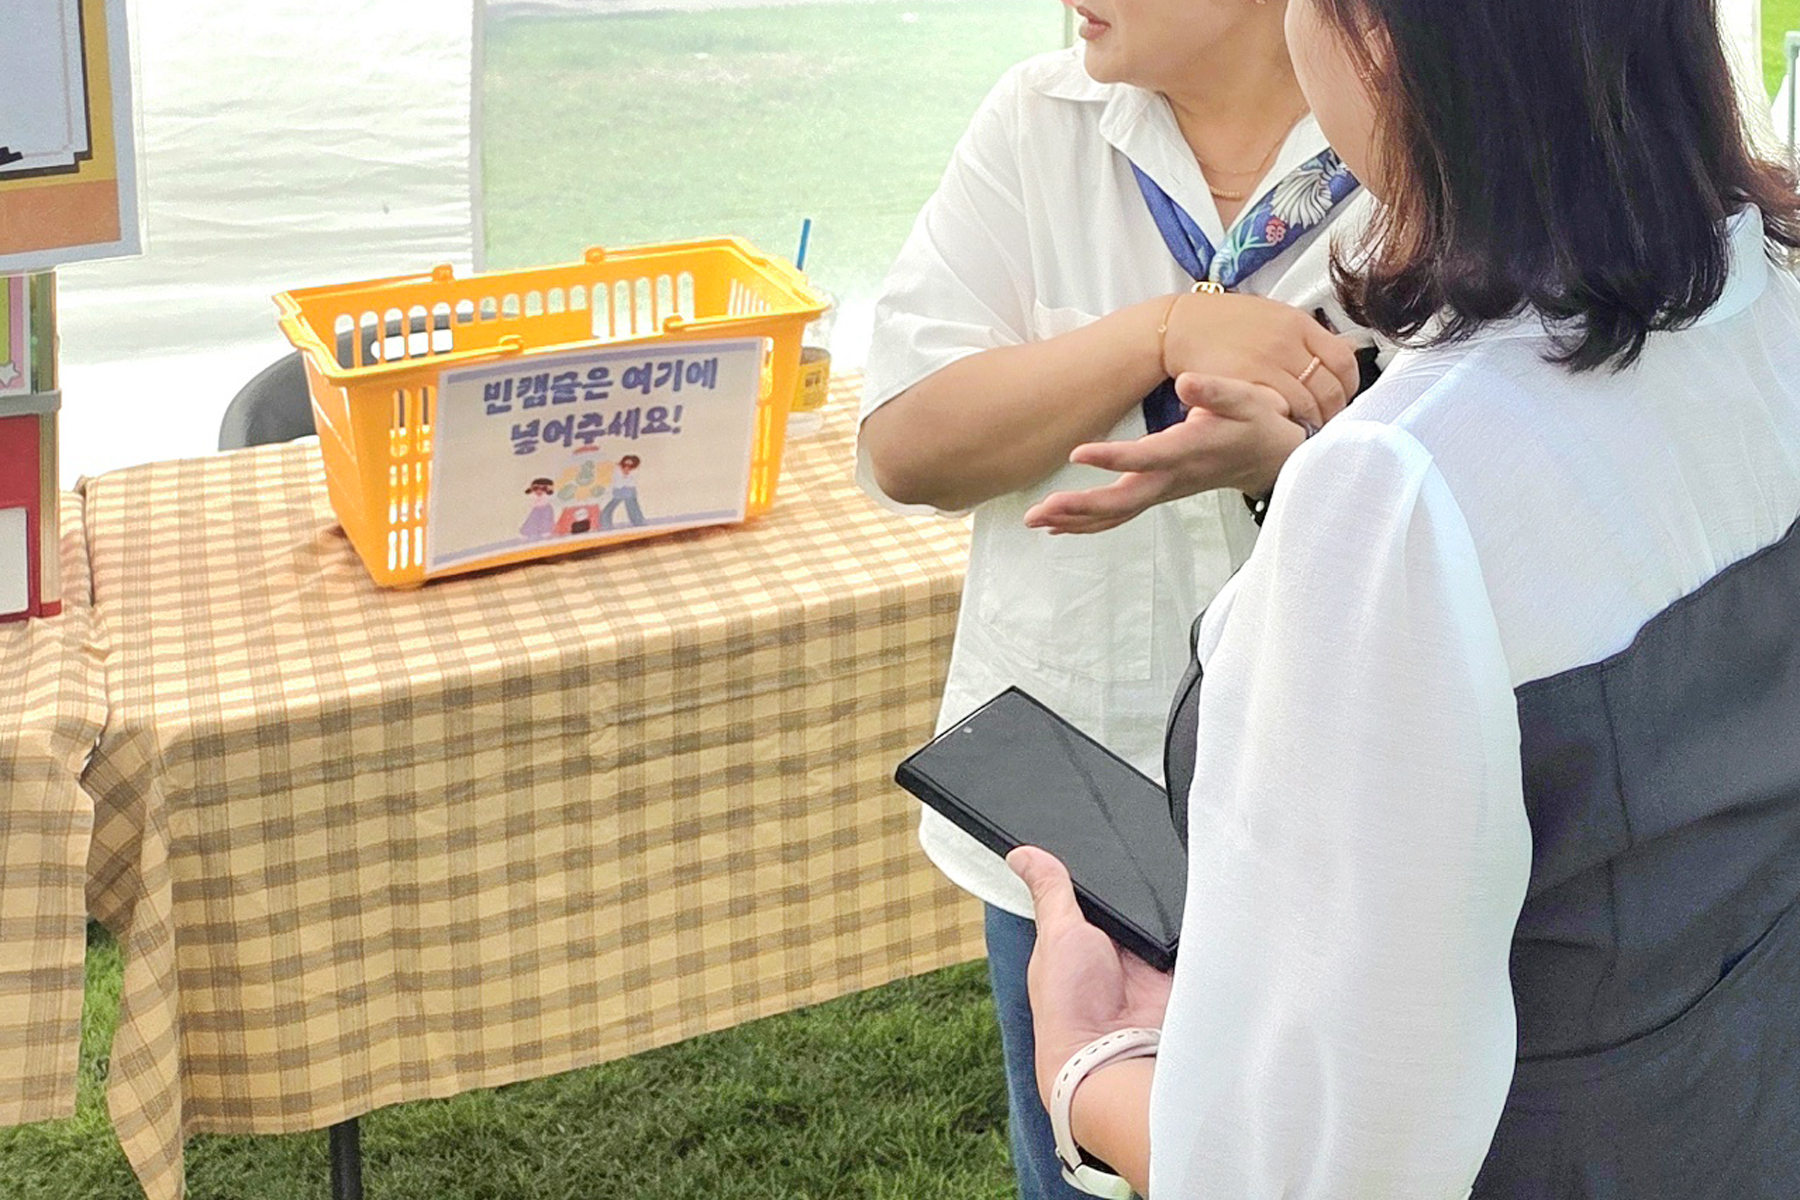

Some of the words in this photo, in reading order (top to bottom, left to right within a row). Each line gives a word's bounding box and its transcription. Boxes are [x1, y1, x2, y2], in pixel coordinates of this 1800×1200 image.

[483, 366, 614, 416] 빈캡슐은
[621, 357, 719, 396] 여기에
[510, 404, 684, 456] 넣어주세요!
